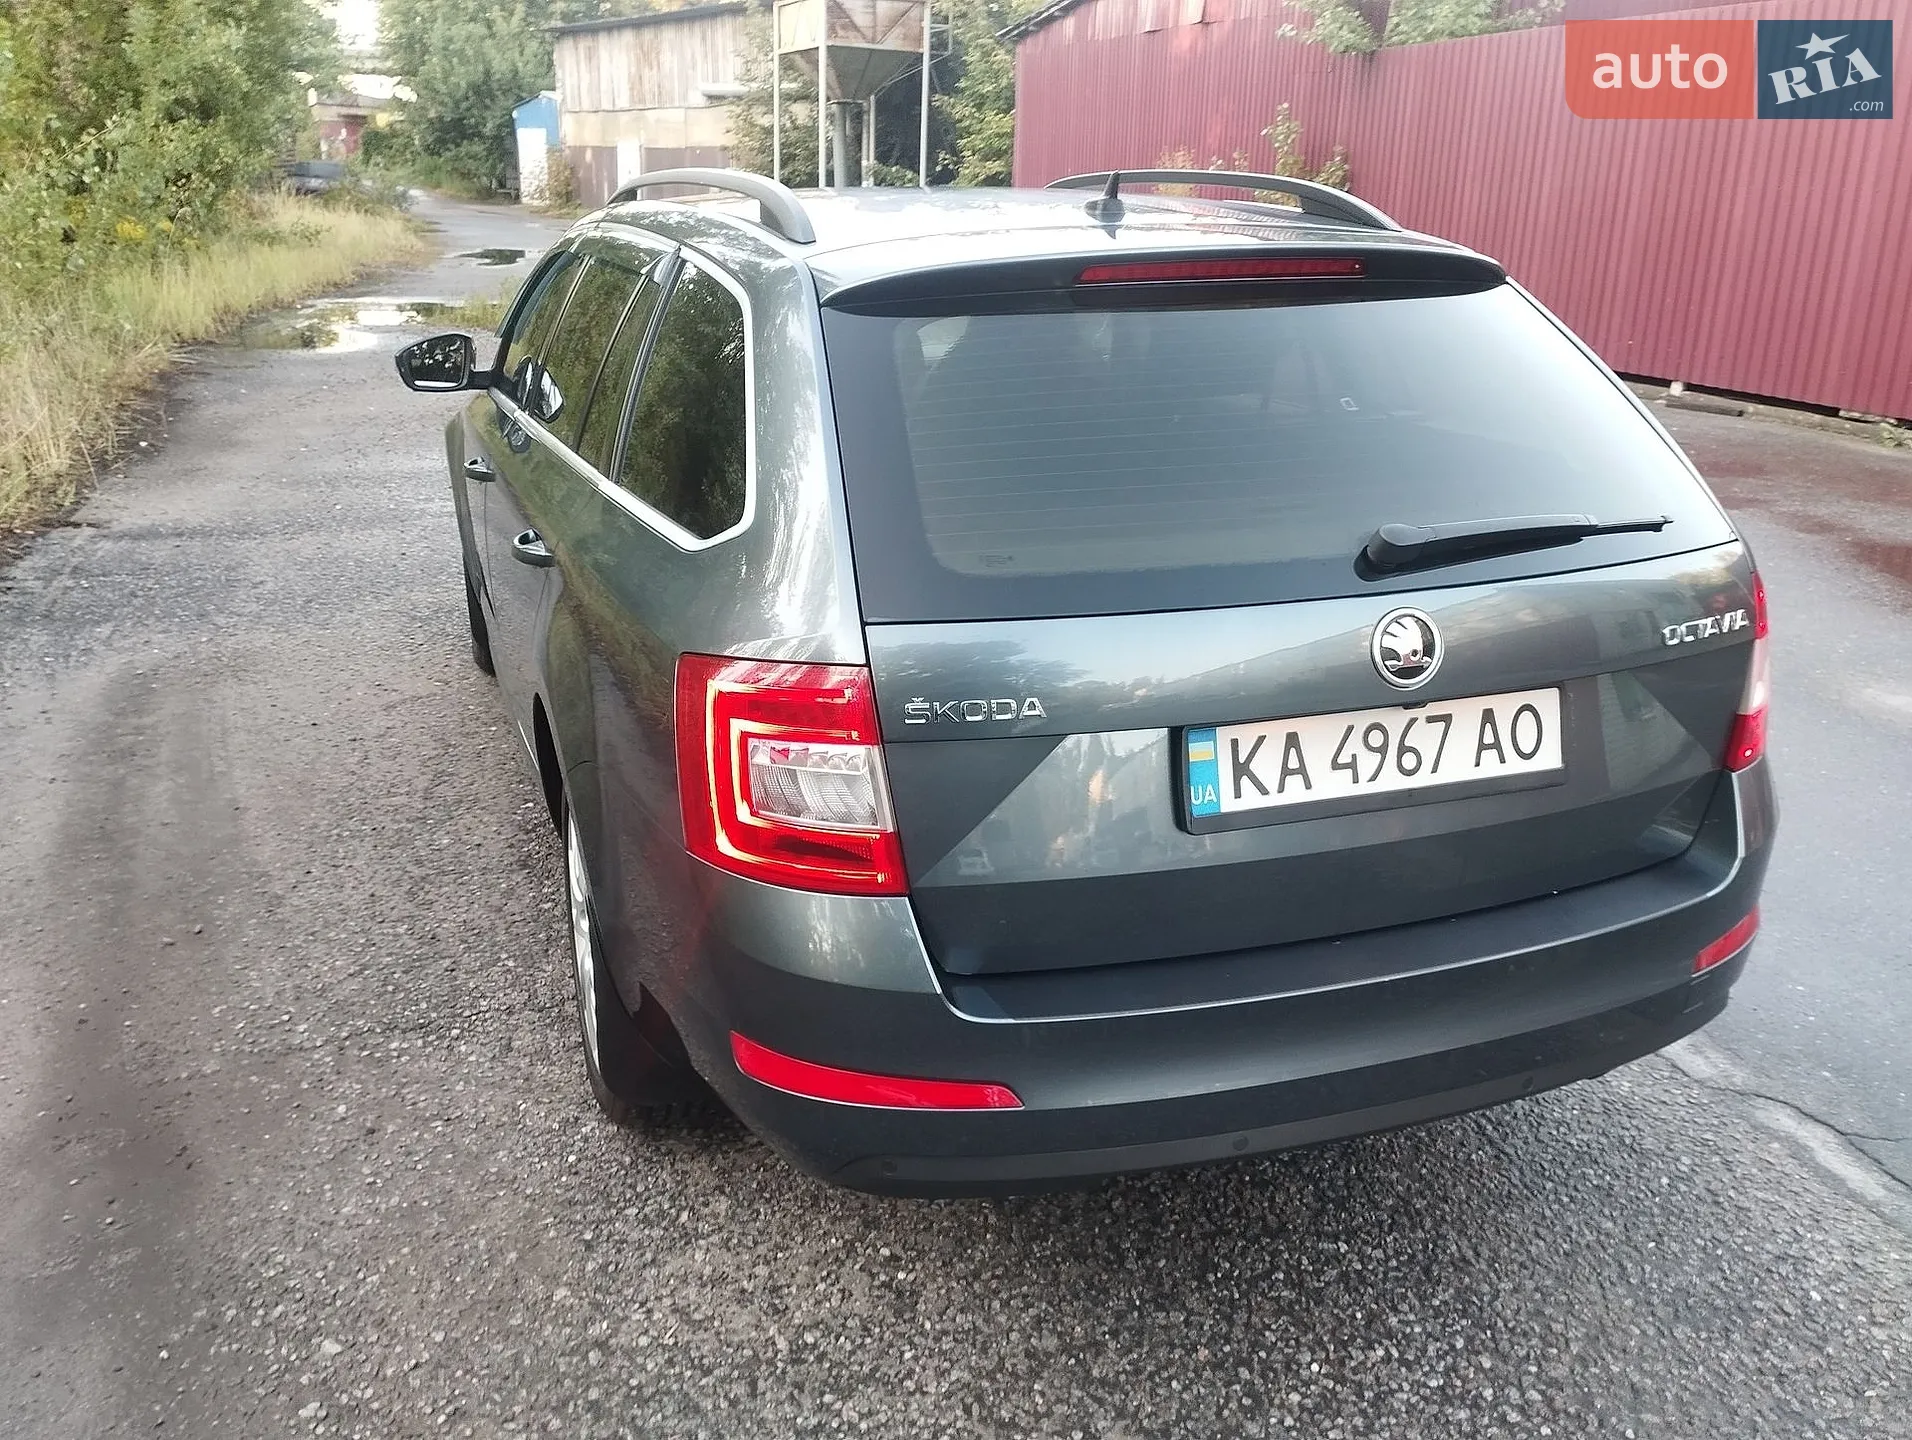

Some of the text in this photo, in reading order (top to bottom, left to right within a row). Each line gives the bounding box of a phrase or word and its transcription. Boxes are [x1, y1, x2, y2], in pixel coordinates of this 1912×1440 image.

[904, 697, 1047, 725] ŠKODA
[1230, 703, 1543, 799] KA 4967 AO
[1190, 784, 1218, 806] UA
